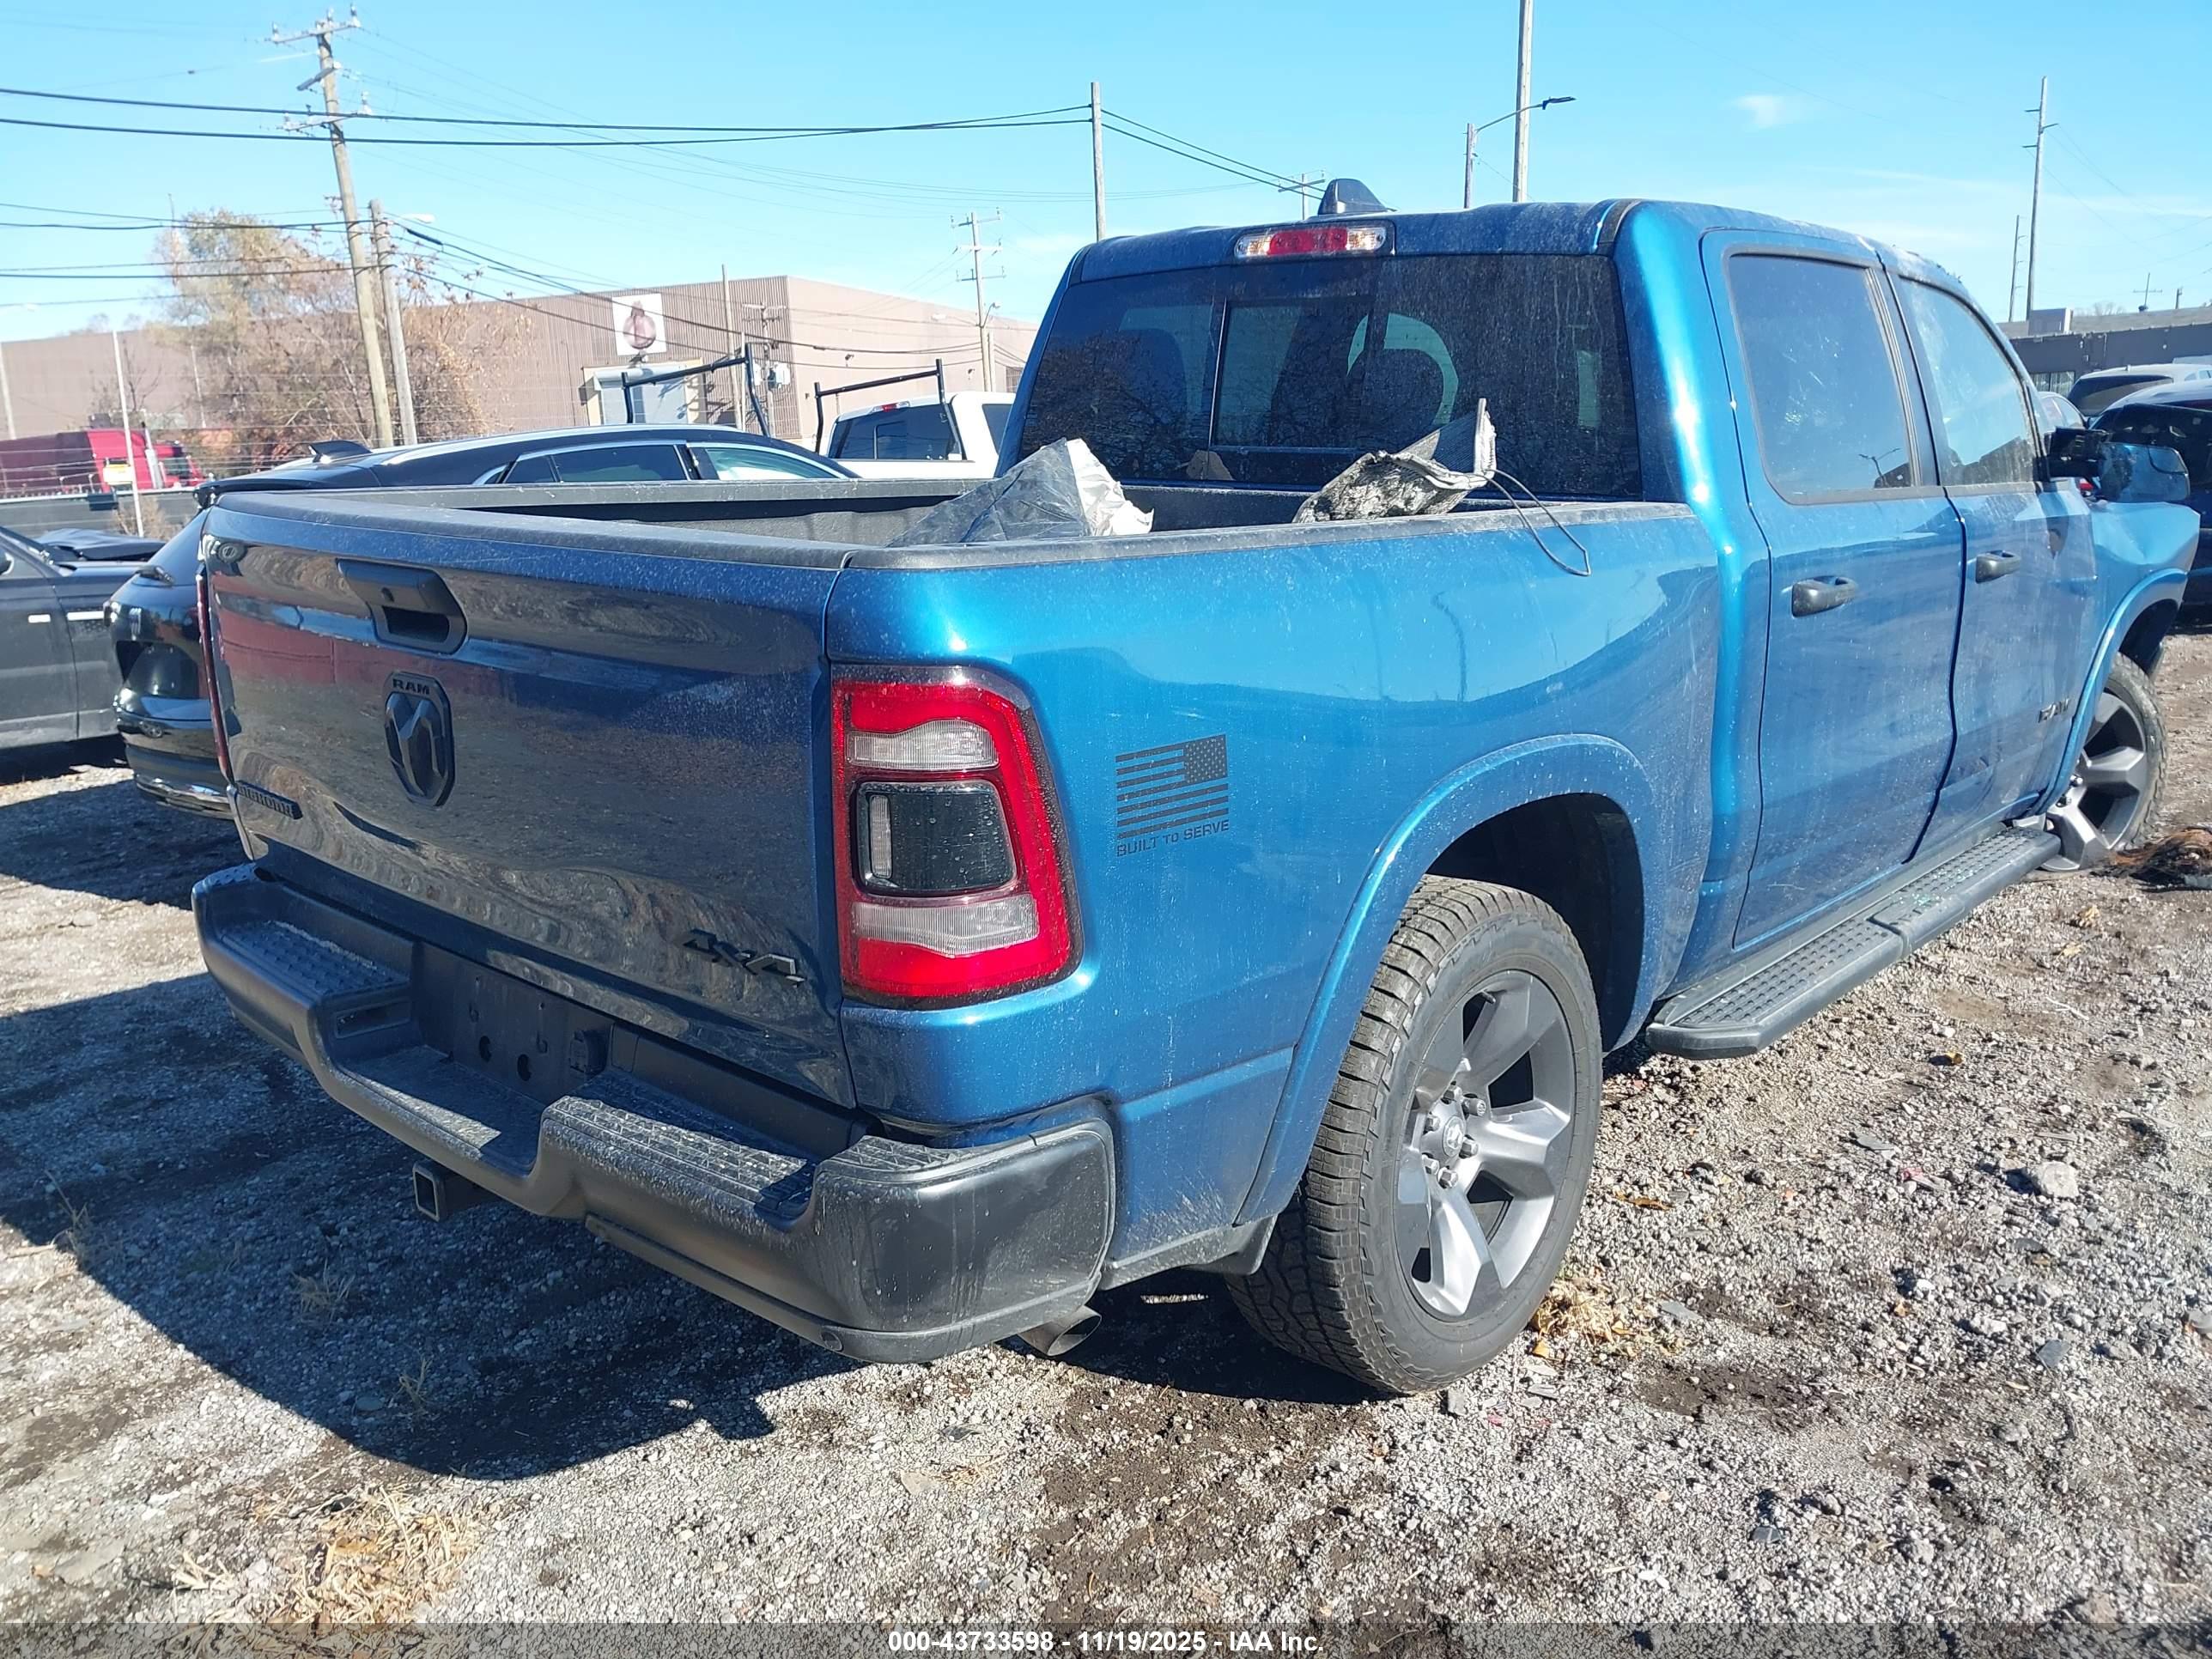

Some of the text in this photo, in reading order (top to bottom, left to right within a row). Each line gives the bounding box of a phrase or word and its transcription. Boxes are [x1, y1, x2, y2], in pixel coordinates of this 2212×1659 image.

[392, 678, 430, 696] RAM
[1116, 819, 1230, 857] BUILT TO SERVE
